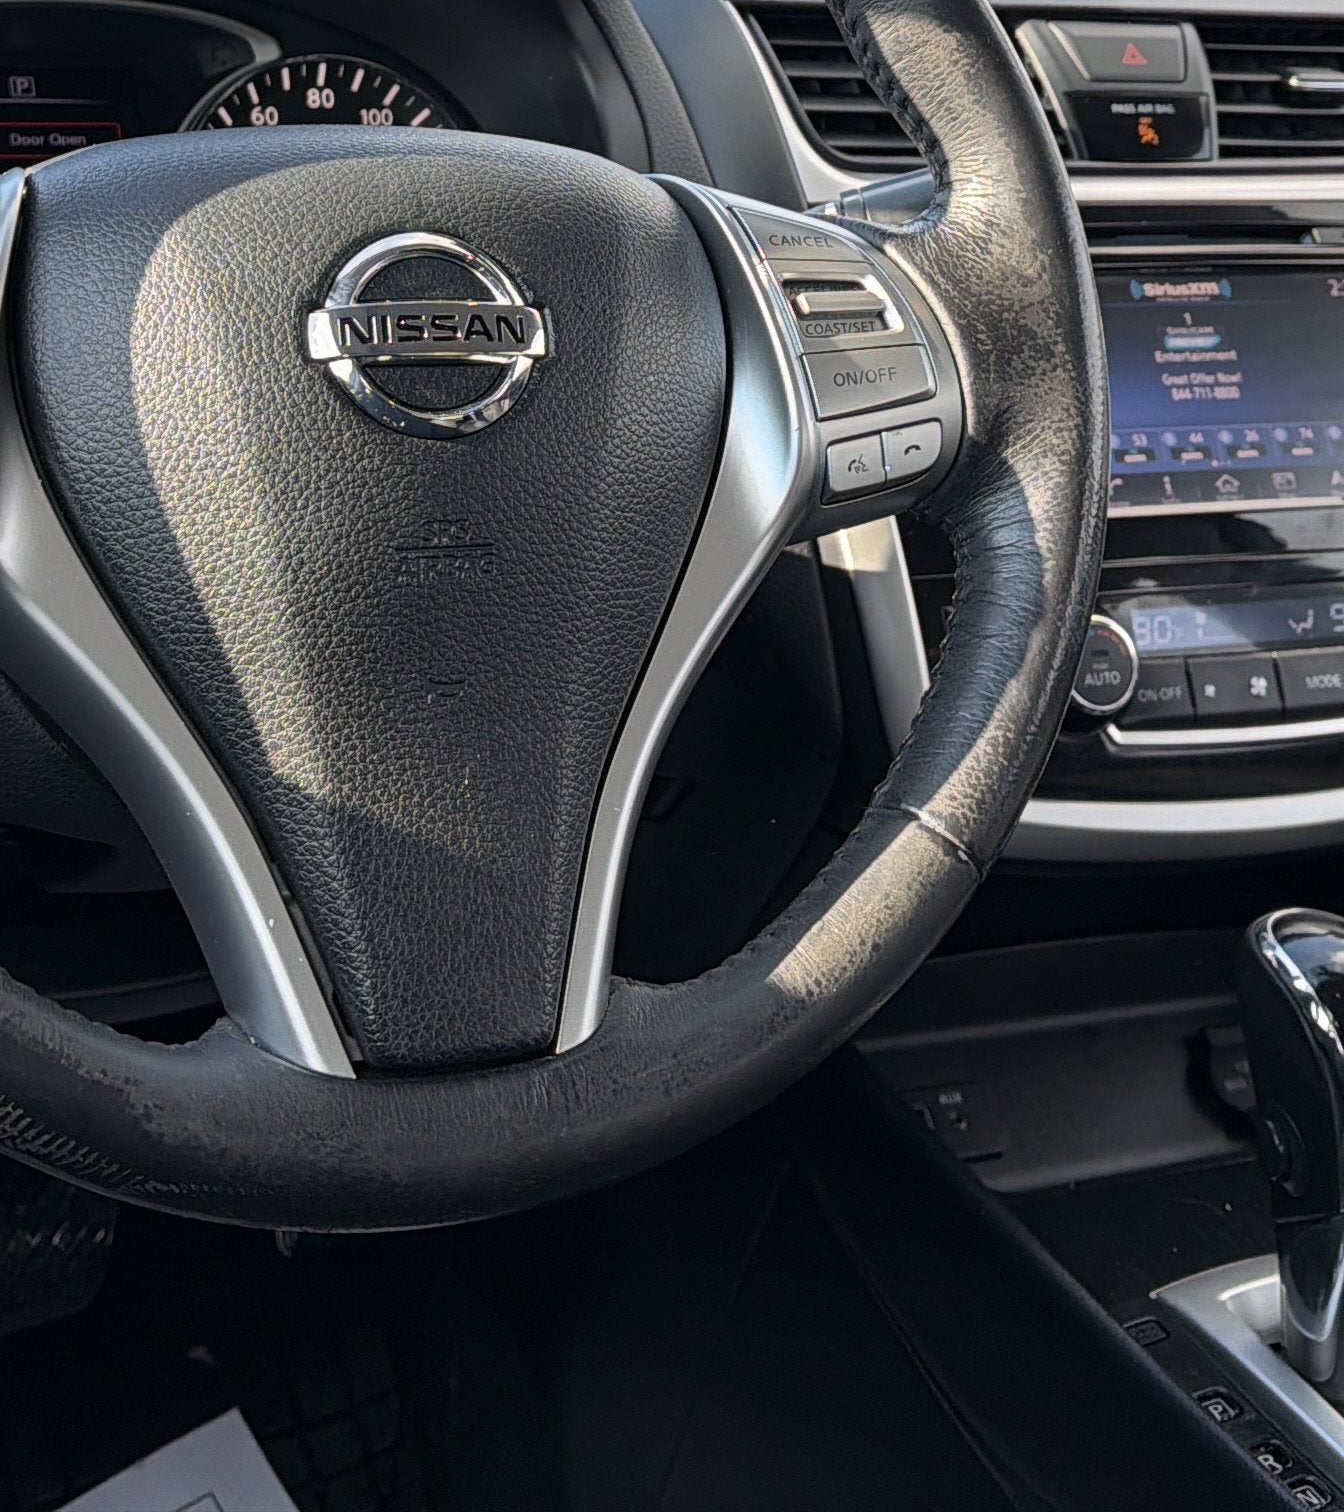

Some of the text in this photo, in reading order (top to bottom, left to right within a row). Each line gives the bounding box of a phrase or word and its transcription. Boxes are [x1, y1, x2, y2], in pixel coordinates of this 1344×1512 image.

[306, 88, 335, 109] 80
[250, 105, 279, 126] 60
[359, 108, 394, 126] 100
[9, 132, 86, 147] Door Open
[768, 233, 834, 249] CANCEL
[336, 313, 526, 347] NISSAN
[805, 320, 876, 336] COAST/SET
[1154, 350, 1238, 364] Entertainment
[833, 366, 897, 388] ON/OFF
[1084, 670, 1121, 686] AUTO
[1305, 673, 1343, 689] MODE
